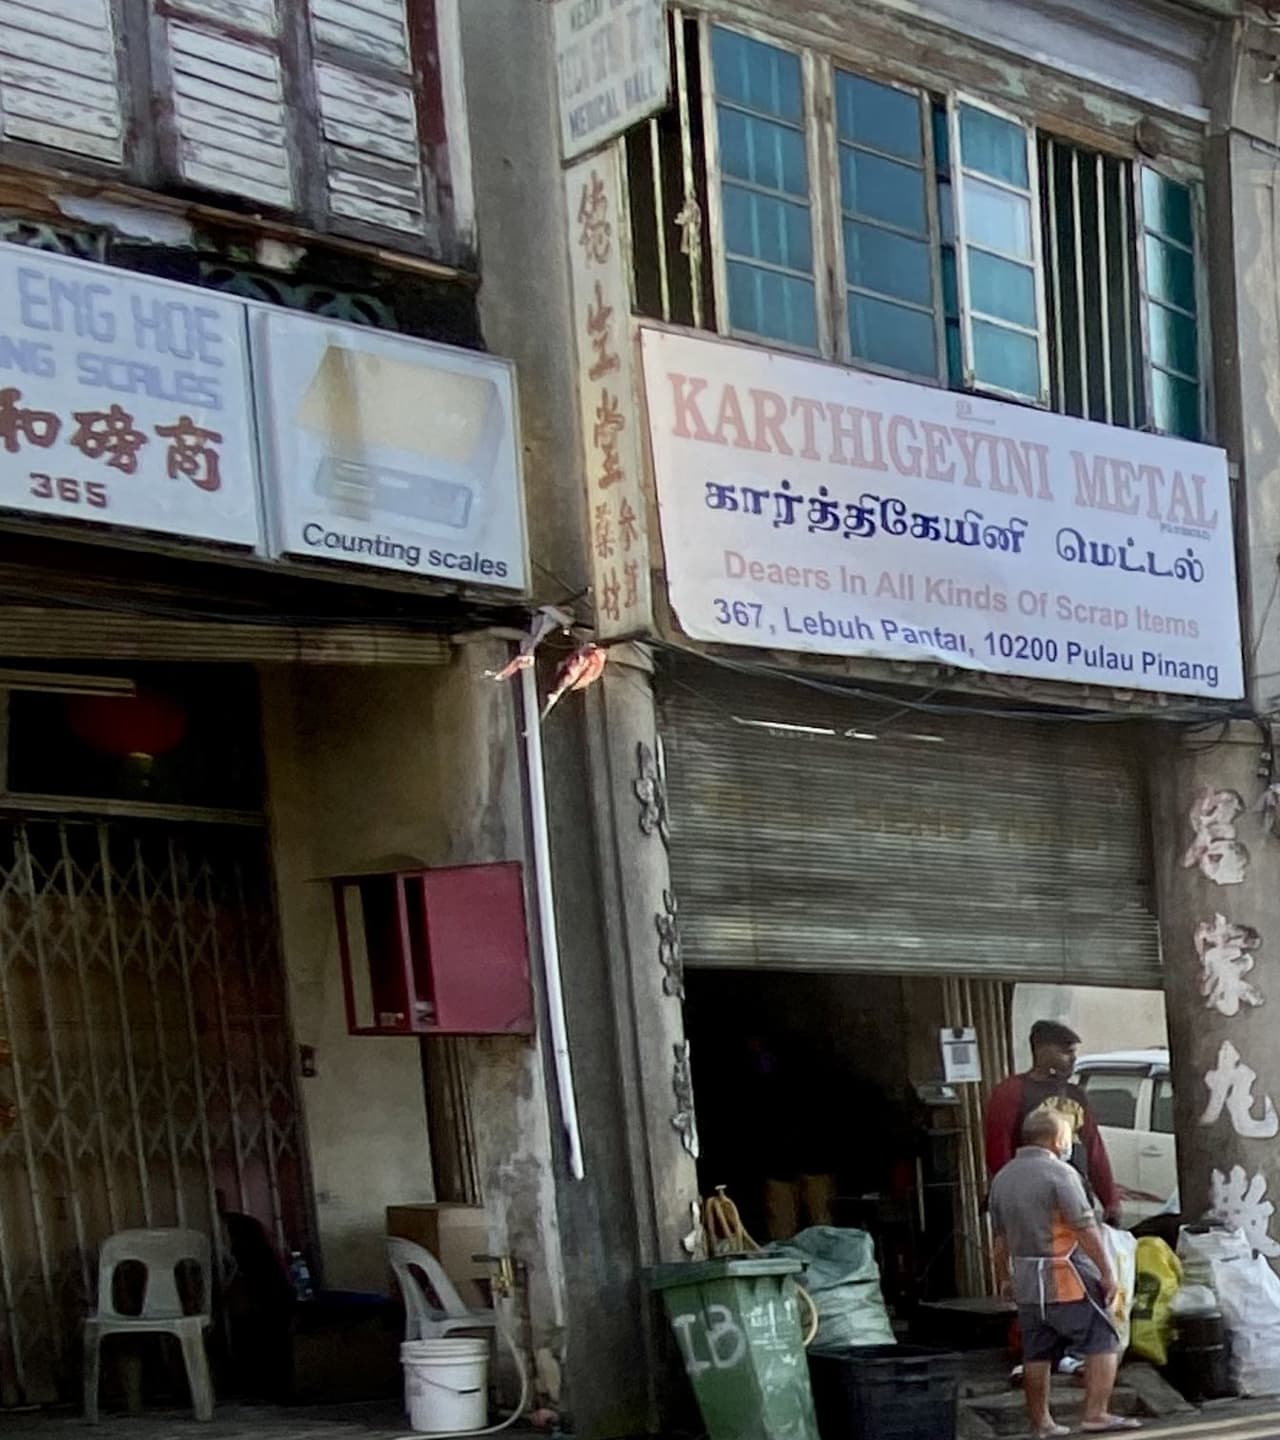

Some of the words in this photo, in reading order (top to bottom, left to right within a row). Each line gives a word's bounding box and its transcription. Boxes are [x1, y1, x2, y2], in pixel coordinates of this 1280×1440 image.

[17, 267, 115, 344] ENG
[131, 293, 225, 368] HOE
[77, 351, 223, 410] SCALES
[30, 472, 108, 508] 365
[667, 372, 1055, 501] KARTHIGEYINI
[1070, 450, 1219, 530] METAL
[303, 522, 421, 566] Counting
[428, 549, 508, 578] scales
[705, 480, 1028, 553] கார்த்திகேயினி
[1056, 528, 1205, 583] மெட்டல்
[724, 550, 831, 592] Deaers
[841, 565, 867, 596] In
[875, 571, 914, 602] All
[926, 577, 1008, 613] Kinds
[1017, 590, 1048, 618] Of
[1056, 595, 1128, 631] Scrap
[1136, 605, 1200, 639] Items
[784, 607, 873, 640] Lebuh
[880, 618, 974, 657] Pantai,
[984, 631, 1058, 662] 10200
[1067, 641, 1134, 672] Pulau
[1142, 651, 1219, 688] Pinang
